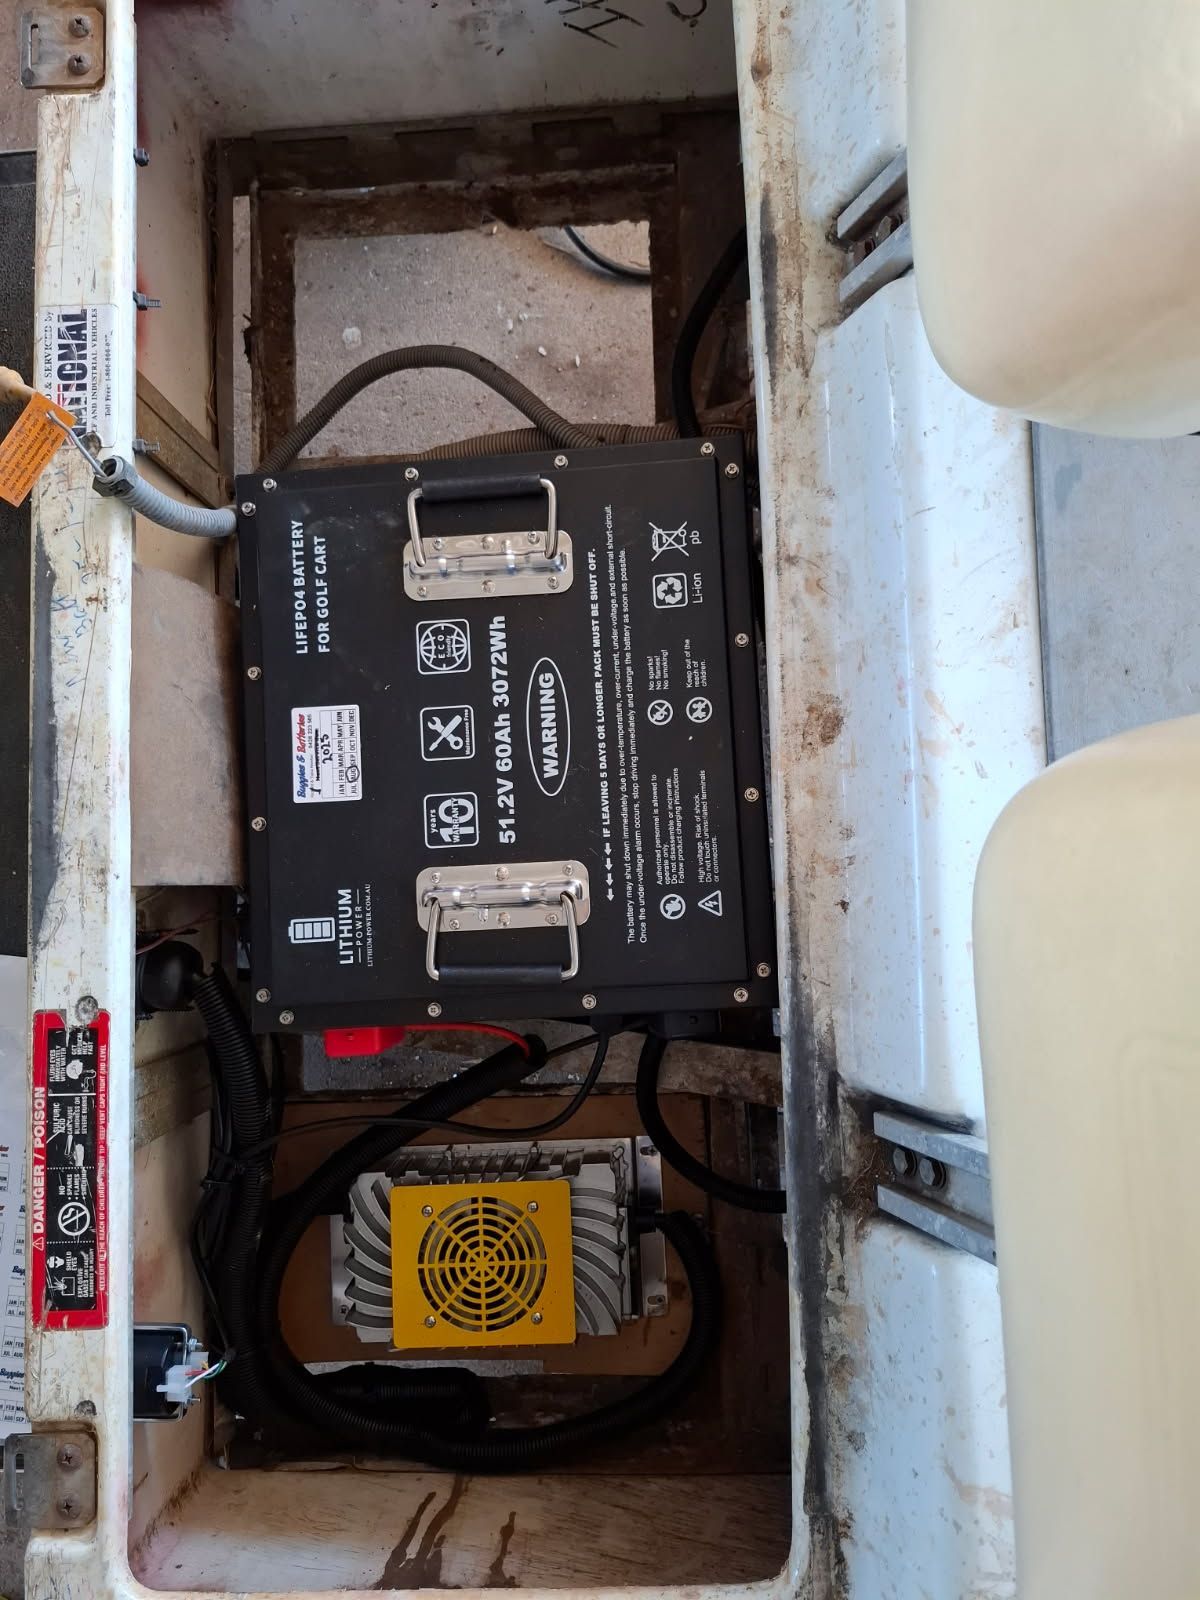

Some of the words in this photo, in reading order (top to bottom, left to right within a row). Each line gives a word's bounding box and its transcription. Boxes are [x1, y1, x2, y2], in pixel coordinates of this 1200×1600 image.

[44, 312, 54, 321] by
[44, 325, 53, 378] SERVICED
[45, 381, 52, 389] &
[690, 530, 700, 544] pb
[291, 520, 304, 586] BATTERY
[314, 535, 326, 574] CART
[607, 550, 615, 581] external
[618, 548, 628, 581] possible.
[316, 578, 328, 618] GOLF
[622, 582, 627, 592] as
[692, 572, 702, 603] Li-ion
[294, 590, 307, 653] LIFEPO4
[591, 603, 598, 616] BE
[623, 613, 628, 623] as
[317, 622, 330, 652] FOR
[437, 634, 445, 659] ECO
[592, 619, 600, 647] MUST
[622, 624, 632, 650] battery
[489, 616, 509, 707] 3072Wh
[593, 650, 602, 677] PACK
[625, 666, 634, 692] charge
[648, 680, 654, 690] No
[655, 680, 661, 690] No
[663, 679, 668, 689] No
[296, 714, 306, 753] Batteries
[539, 672, 558, 778] WARNING
[597, 725, 605, 739] OR
[615, 700, 626, 766] over-temperature,
[627, 709, 637, 754] immediately
[320, 734, 333, 763] 2025
[494, 713, 512, 772] 60Ah
[598, 742, 606, 769] DAYS
[630, 756, 639, 781] driving
[496, 777, 515, 843] 51.2V
[600, 780, 609, 825] LEAVING
[620, 793, 630, 839] immediately
[438, 798, 475, 843] 10
[451, 797, 460, 843] WARRANTY
[603, 827, 610, 837] IF
[653, 815, 661, 848] personnel
[635, 853, 646, 906] under-voltage
[663, 859, 671, 884] operate
[671, 874, 677, 884] Do
[705, 872, 711, 882] Do
[338, 889, 353, 964] LITHIUM
[626, 899, 634, 926] battery
[98, 1045, 106, 1061] LEVEL
[34, 1087, 45, 1148] POISON
[34, 1165, 45, 1233] DANGER
[59, 1185, 65, 1195] NO
[98, 1211, 106, 1220] OF
[98, 1241, 106, 1253] THE
